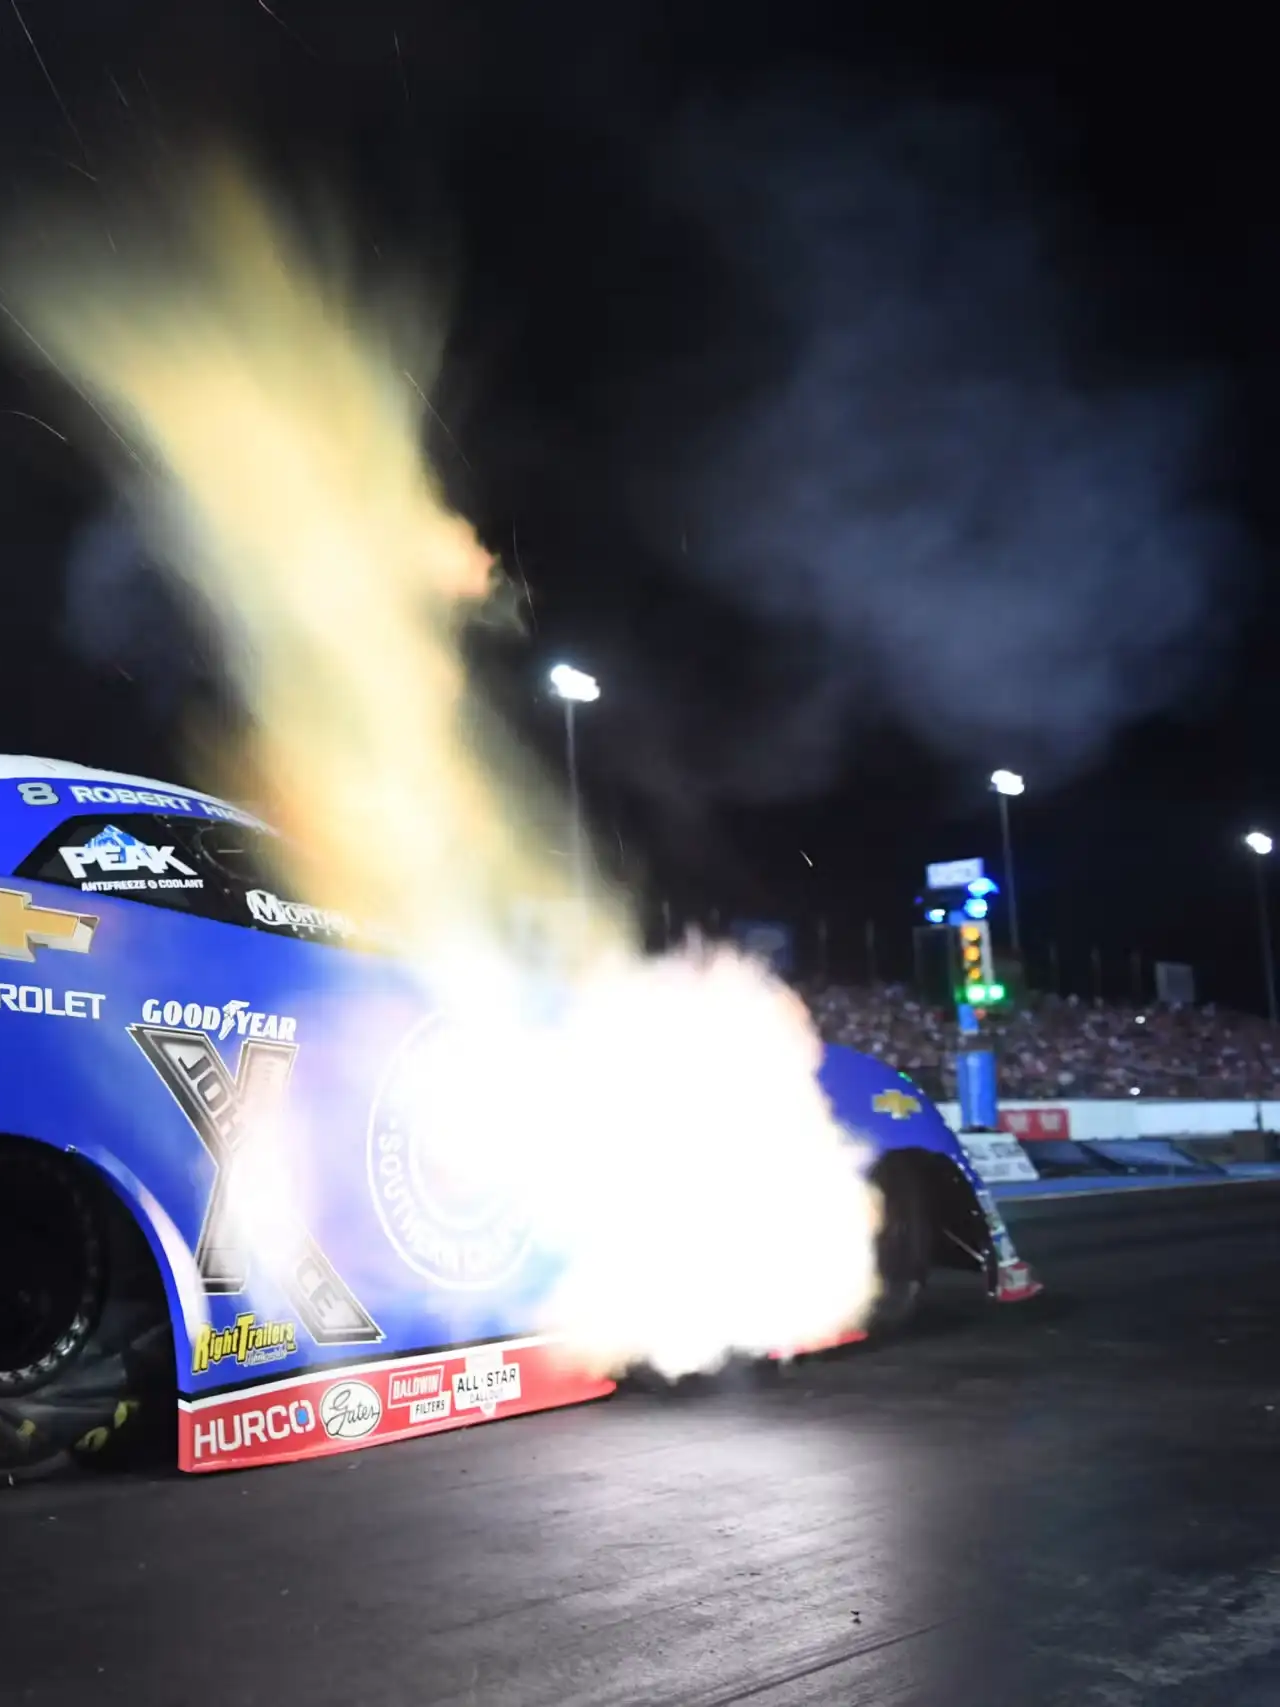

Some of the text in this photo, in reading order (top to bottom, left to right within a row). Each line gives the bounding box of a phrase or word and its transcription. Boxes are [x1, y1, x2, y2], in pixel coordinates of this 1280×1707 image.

[17, 781, 192, 813] 8 ROBERT
[58, 843, 198, 879] PEAK
[81, 880, 147, 893] ANTIFREEZE
[158, 878, 204, 890] COOLANT
[393, 1374, 441, 1400] BALDWIN
[486, 1368, 516, 1387] STAR
[415, 1400, 445, 1415] FILTERS
[194, 1399, 316, 1459] HURCO
